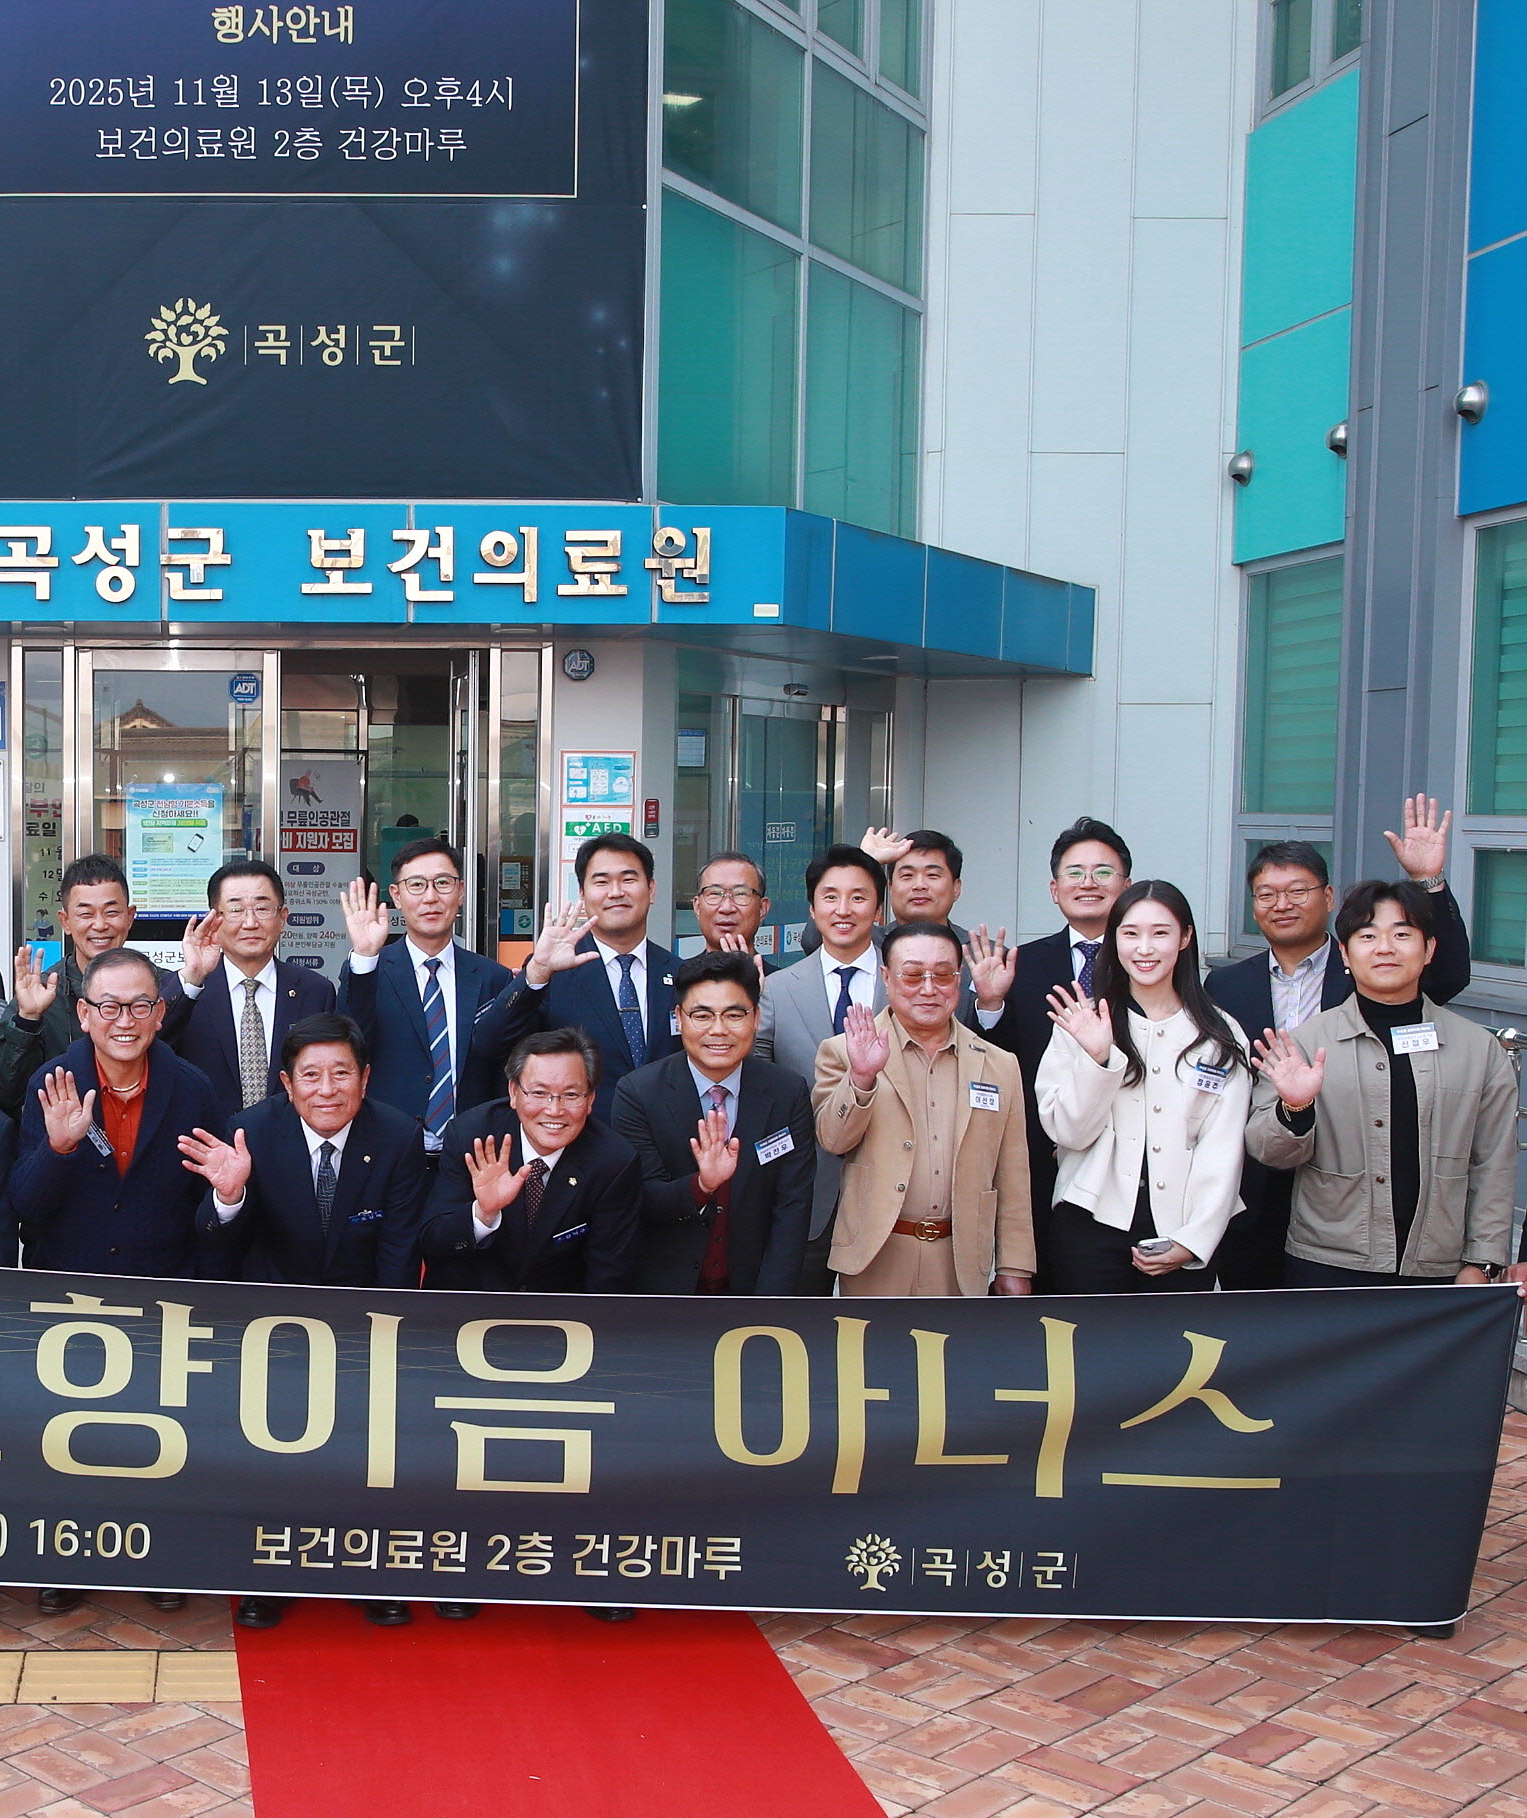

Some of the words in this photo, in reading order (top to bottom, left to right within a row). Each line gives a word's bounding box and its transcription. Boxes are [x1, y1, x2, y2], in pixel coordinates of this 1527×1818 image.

[211, 4, 354, 45] 행사안내
[49, 74, 156, 108] 2025년
[173, 74, 240, 108] 11월
[258, 74, 384, 110] 13일(목)
[401, 75, 514, 111] 오후4시
[95, 126, 258, 161] 보건의료원
[273, 127, 324, 161] 2층
[338, 126, 468, 162] 건강마루
[254, 325, 406, 366] 곡성군
[301, 526, 712, 605] 보건의료원
[233, 682, 256, 694] ADT
[286, 810, 351, 827] 무릎인공관절
[591, 822, 623, 834] AED
[40, 848, 51, 856] 11
[295, 831, 330, 849] 지원자
[331, 832, 354, 850] 모집
[42, 870, 54, 879] 12
[38, 892, 49, 901] 수
[291, 915, 320, 924] 지원범위
[712, 1315, 1282, 1498] 아너스
[29, 1518, 152, 1560] 16:00
[253, 1526, 468, 1573] 보건의료원
[486, 1531, 555, 1575] 2층
[572, 1532, 743, 1581] 건강마루
[921, 1547, 1068, 1589] 곡성군
